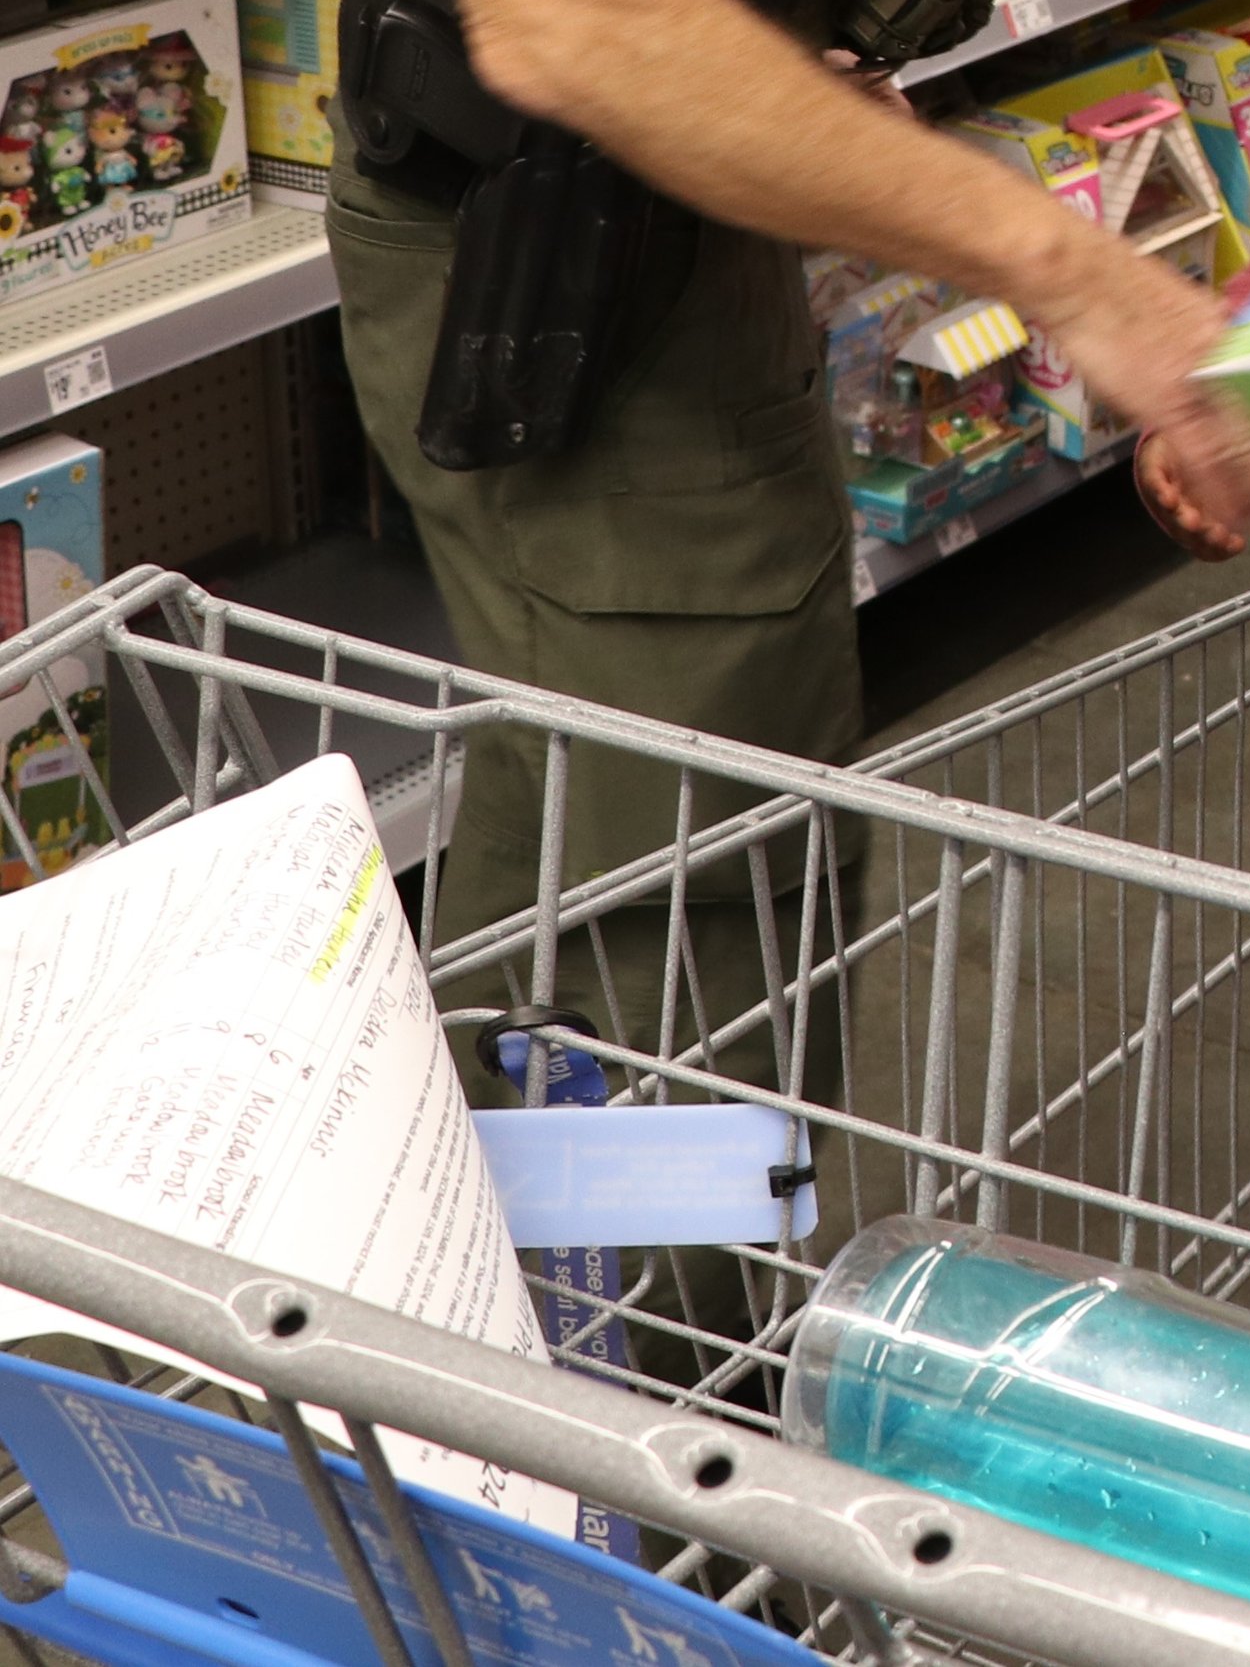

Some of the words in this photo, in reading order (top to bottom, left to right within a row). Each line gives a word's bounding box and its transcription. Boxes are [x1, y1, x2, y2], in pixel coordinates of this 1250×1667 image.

[63, 214, 128, 258] Honey
[129, 201, 168, 232] Bee
[269, 1050, 292, 1064] 6
